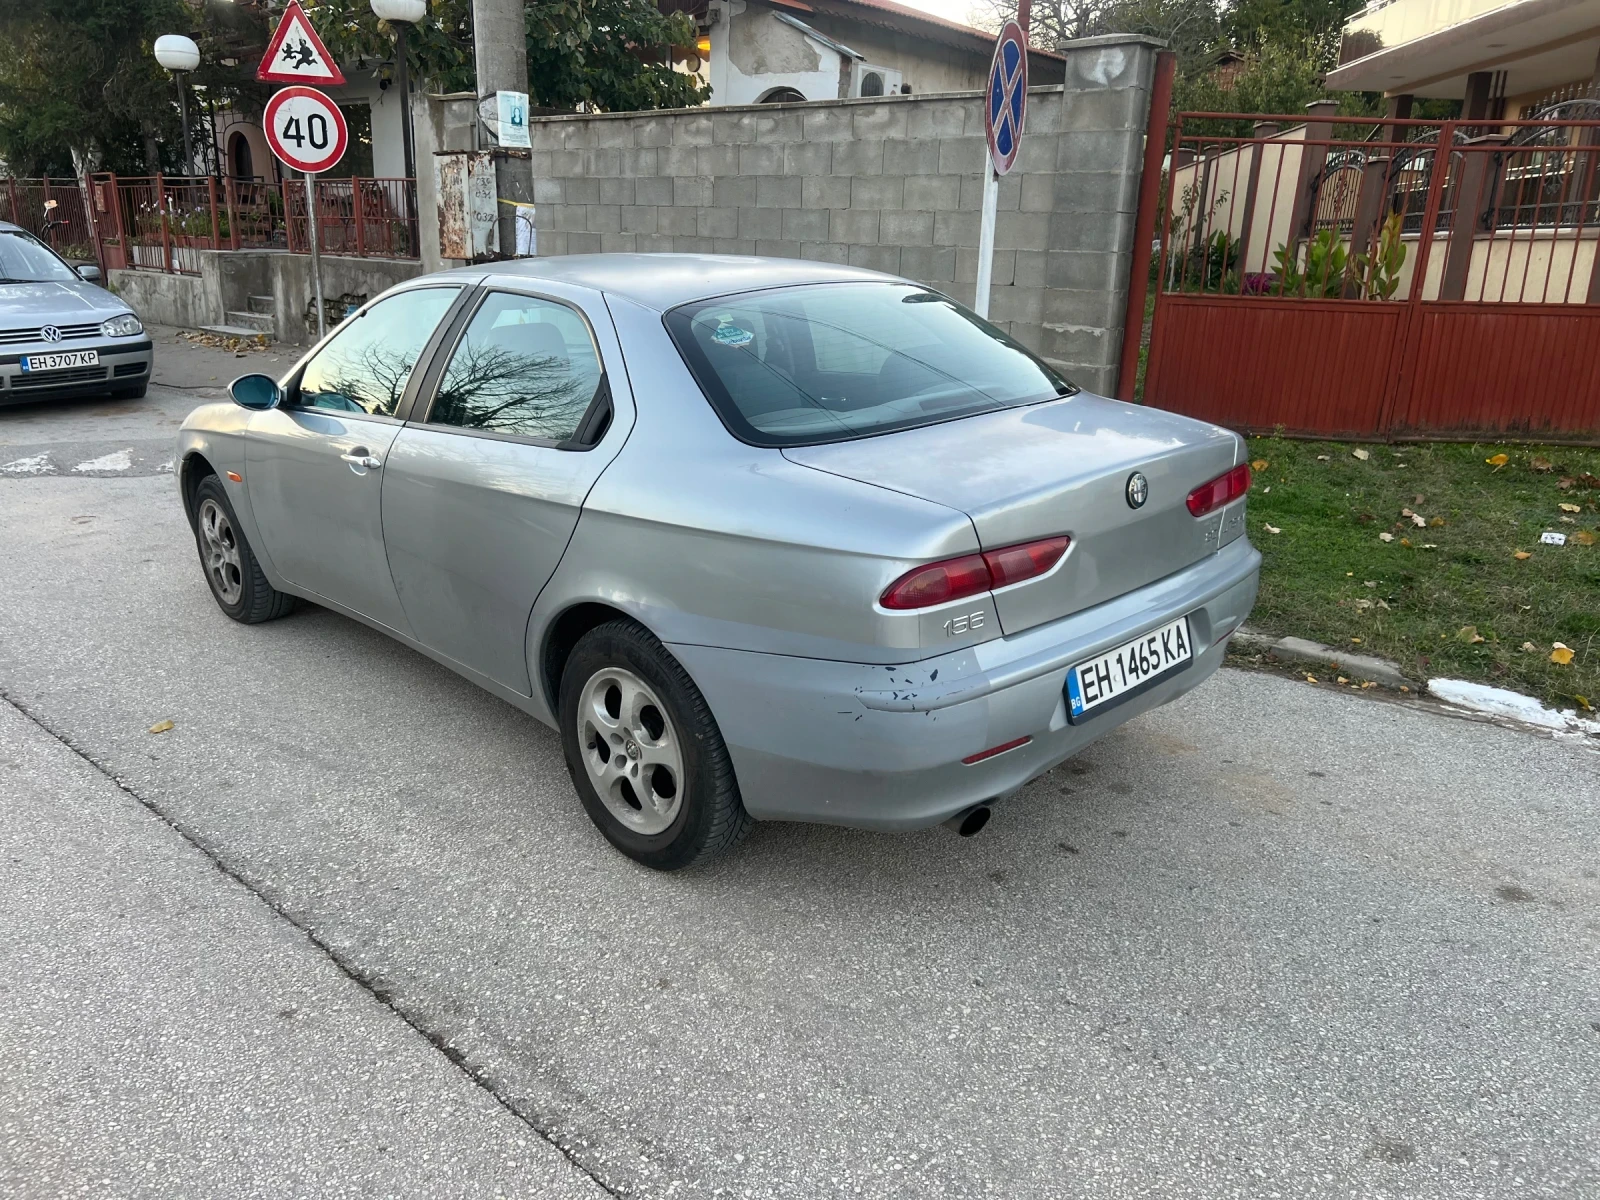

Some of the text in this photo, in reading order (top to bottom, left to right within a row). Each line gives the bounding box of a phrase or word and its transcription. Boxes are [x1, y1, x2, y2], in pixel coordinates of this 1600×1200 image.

[283, 113, 328, 150] 40
[29, 352, 96, 370] EH 3707 KP
[943, 610, 984, 638] 156
[1080, 625, 1188, 705] EH 1465 KA
[1071, 697, 1081, 710] BG
